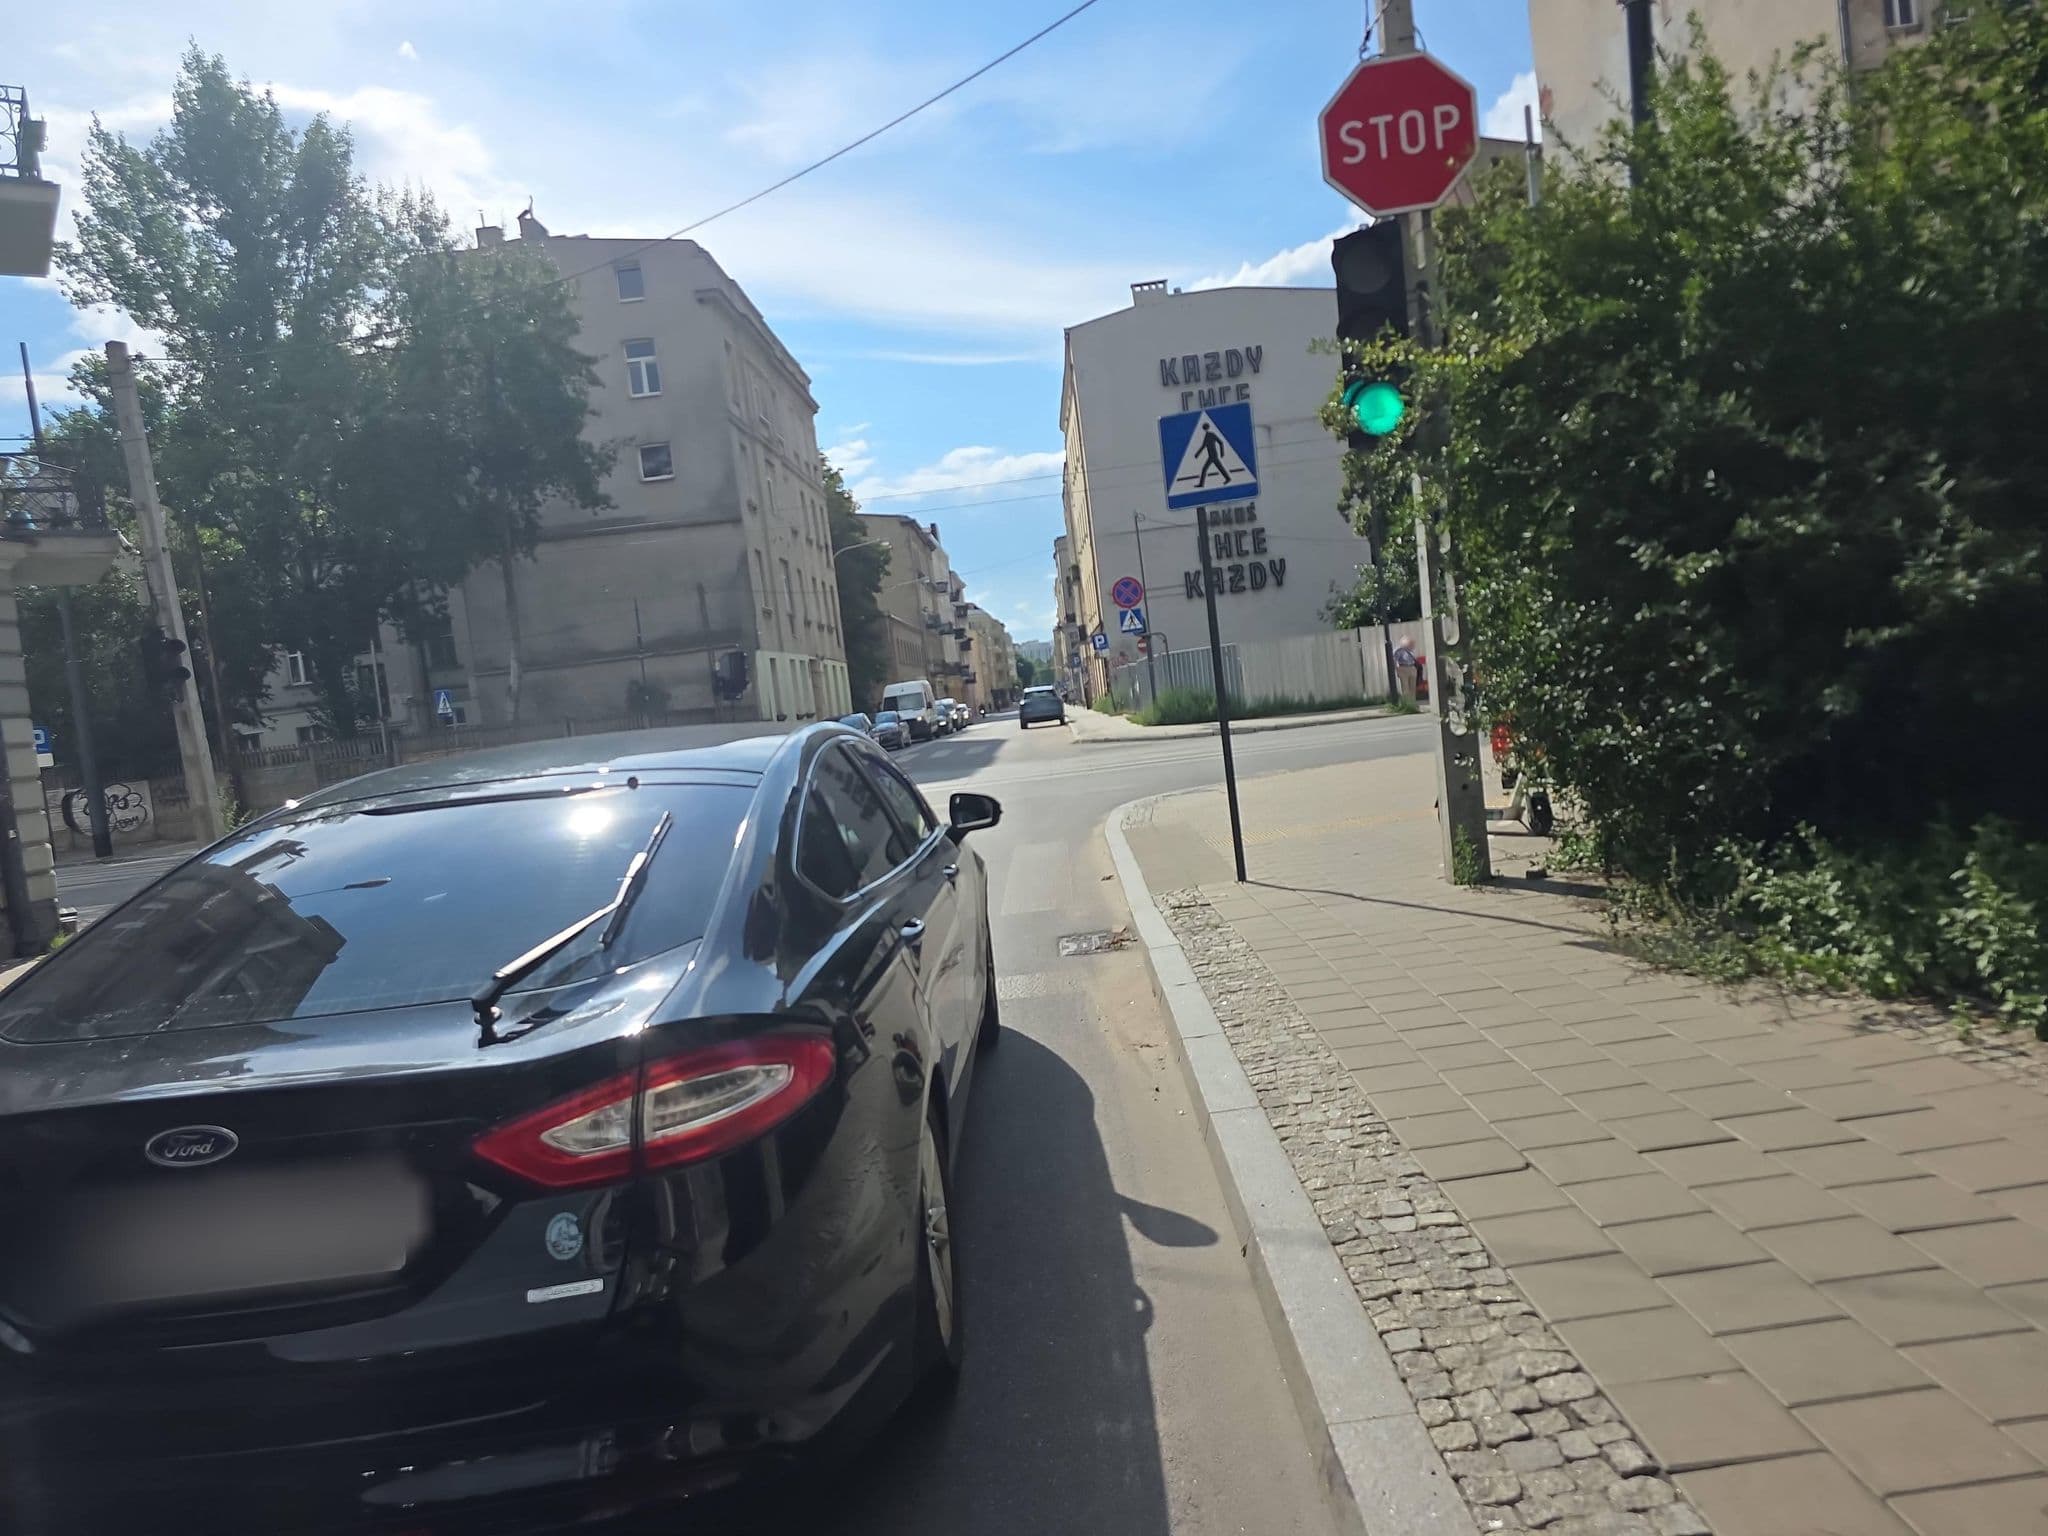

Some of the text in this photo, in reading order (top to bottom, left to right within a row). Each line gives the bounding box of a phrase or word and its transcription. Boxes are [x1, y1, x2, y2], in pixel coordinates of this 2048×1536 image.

[1339, 104, 1461, 165] STOP
[1095, 634, 1105, 649] P
[162, 1133, 215, 1158] Ford
